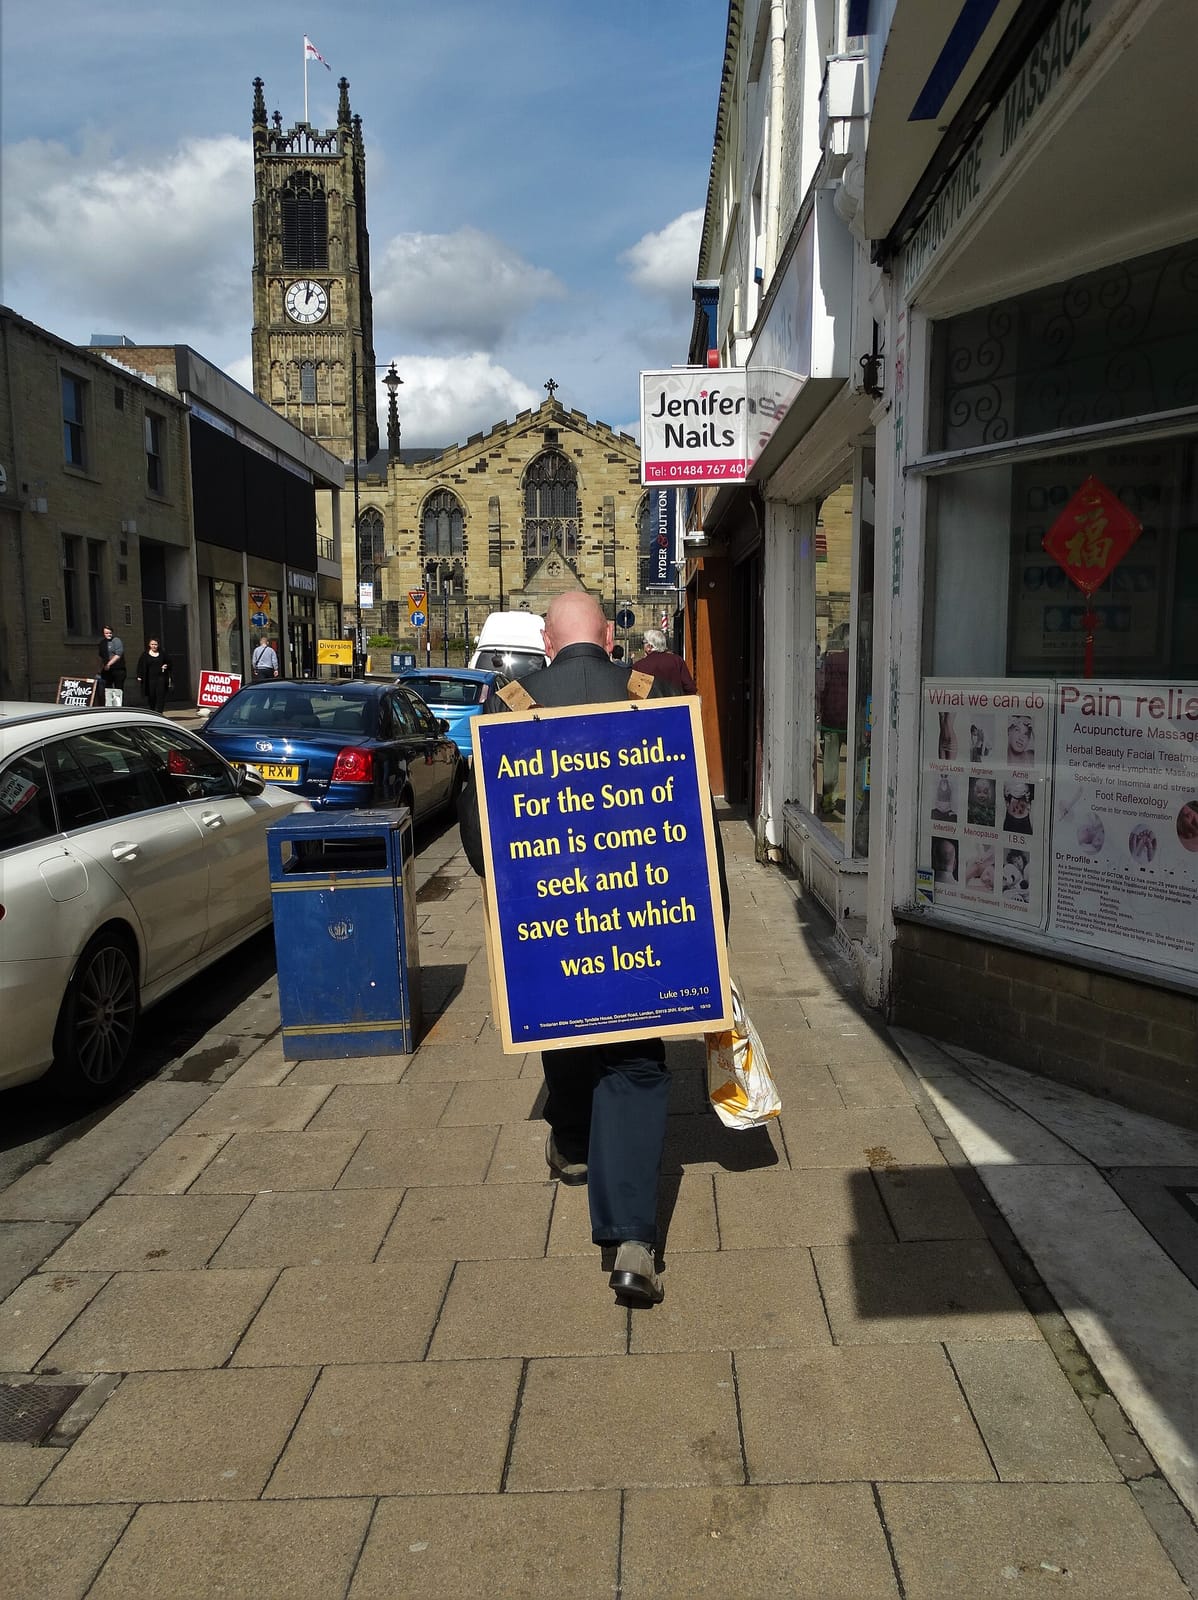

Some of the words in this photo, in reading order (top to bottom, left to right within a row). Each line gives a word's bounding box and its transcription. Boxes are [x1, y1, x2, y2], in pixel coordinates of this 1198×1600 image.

[1000, 0, 1091, 157] MASSAGE
[652, 390, 745, 417] Jenifer
[665, 422, 735, 449] Nails
[650, 466, 667, 477] Tel:
[670, 465, 704, 476] 01484
[706, 465, 726, 474] 767
[658, 490, 667, 534] DUTTON
[1064, 507, 1114, 569] 福
[658, 548, 667, 578] RYDER
[319, 642, 352, 650] Diversion
[208, 674, 231, 685] ROAD
[204, 683, 232, 694] AHEAD
[928, 688, 964, 706] What
[967, 694, 988, 707] we
[993, 694, 1020, 708] can
[1025, 690, 1044, 709] do
[1060, 686, 1122, 717] Pain
[1073, 722, 1144, 738] Acupuncture
[497, 749, 544, 778] And
[551, 750, 610, 778] Jesus
[618, 737, 686, 766] said...
[1066, 744, 1093, 755] Herbal
[1095, 746, 1125, 759] Beauty
[1127, 748, 1155, 760] Facial
[268, 765, 293, 778] RXW
[930, 762, 949, 772] Weight
[950, 765, 964, 773] Loss
[971, 767, 993, 776] Migraine
[1069, 759, 1081, 767] Ear
[1082, 760, 1106, 770] Candle
[1107, 762, 1121, 771] and
[1012, 770, 1029, 779] Acne
[1074, 773, 1104, 785] Specially
[1105, 777, 1116, 786] for
[1117, 778, 1151, 790] Insomnia
[1152, 782, 1169, 791] and
[1171, 785, 1196, 794] stress
[513, 794, 551, 818] For
[557, 787, 595, 814] the
[601, 784, 645, 809] Son
[651, 776, 674, 804] of
[1095, 789, 1115, 801] Foot
[1115, 792, 1169, 810] Reflexology
[1090, 804, 1109, 812] Come
[1115, 806, 1123, 814] for
[1123, 808, 1138, 816] more
[1138, 810, 1173, 821] information
[933, 823, 957, 834] Infertility
[964, 827, 999, 840] Menopause
[510, 836, 561, 859] man
[567, 827, 587, 853] is
[594, 826, 657, 850] come
[662, 820, 687, 842] to
[1055, 852, 1065, 860] Dr
[1066, 854, 1091, 864] Profile
[536, 867, 590, 898] seek
[596, 861, 639, 891] and
[645, 862, 669, 885] to
[1124, 881, 1148, 890] Traditional
[1148, 885, 1168, 894] Chinese
[944, 889, 957, 897] Loss
[1154, 893, 1164, 901] help
[1165, 895, 1180, 904] people
[1003, 902, 1028, 913] Insomnia
[517, 918, 569, 941] save
[575, 907, 622, 934] that
[627, 897, 696, 928] which
[1075, 915, 1092, 924] Chinese
[1116, 924, 1144, 936] Acupuncture
[561, 955, 606, 977] was
[612, 944, 662, 971] lost.
[659, 990, 678, 1000] Luke
[680, 986, 709, 998] 19.9,10
